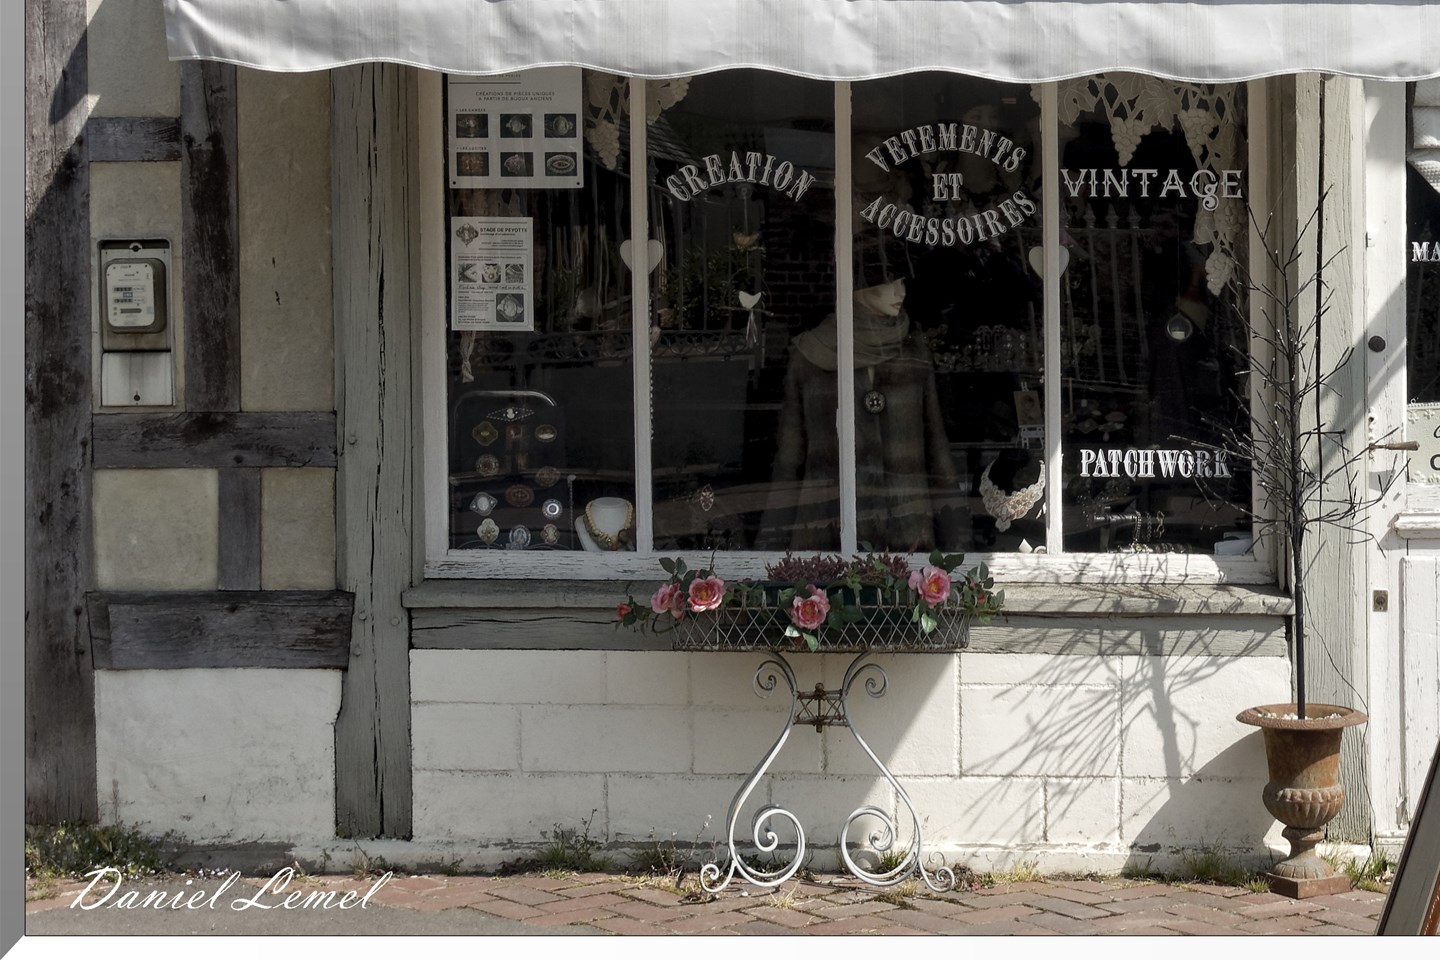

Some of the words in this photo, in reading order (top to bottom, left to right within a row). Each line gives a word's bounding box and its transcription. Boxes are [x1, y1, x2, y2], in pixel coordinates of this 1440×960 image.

[865, 122, 1027, 173] VETEMENTS
[666, 150, 817, 204] CREATION
[932, 173, 964, 202] ET
[1059, 169, 1243, 211] VINTAGE
[859, 189, 1038, 247] ACCESSOIRES
[1079, 449, 1233, 478] PATCHWORK
